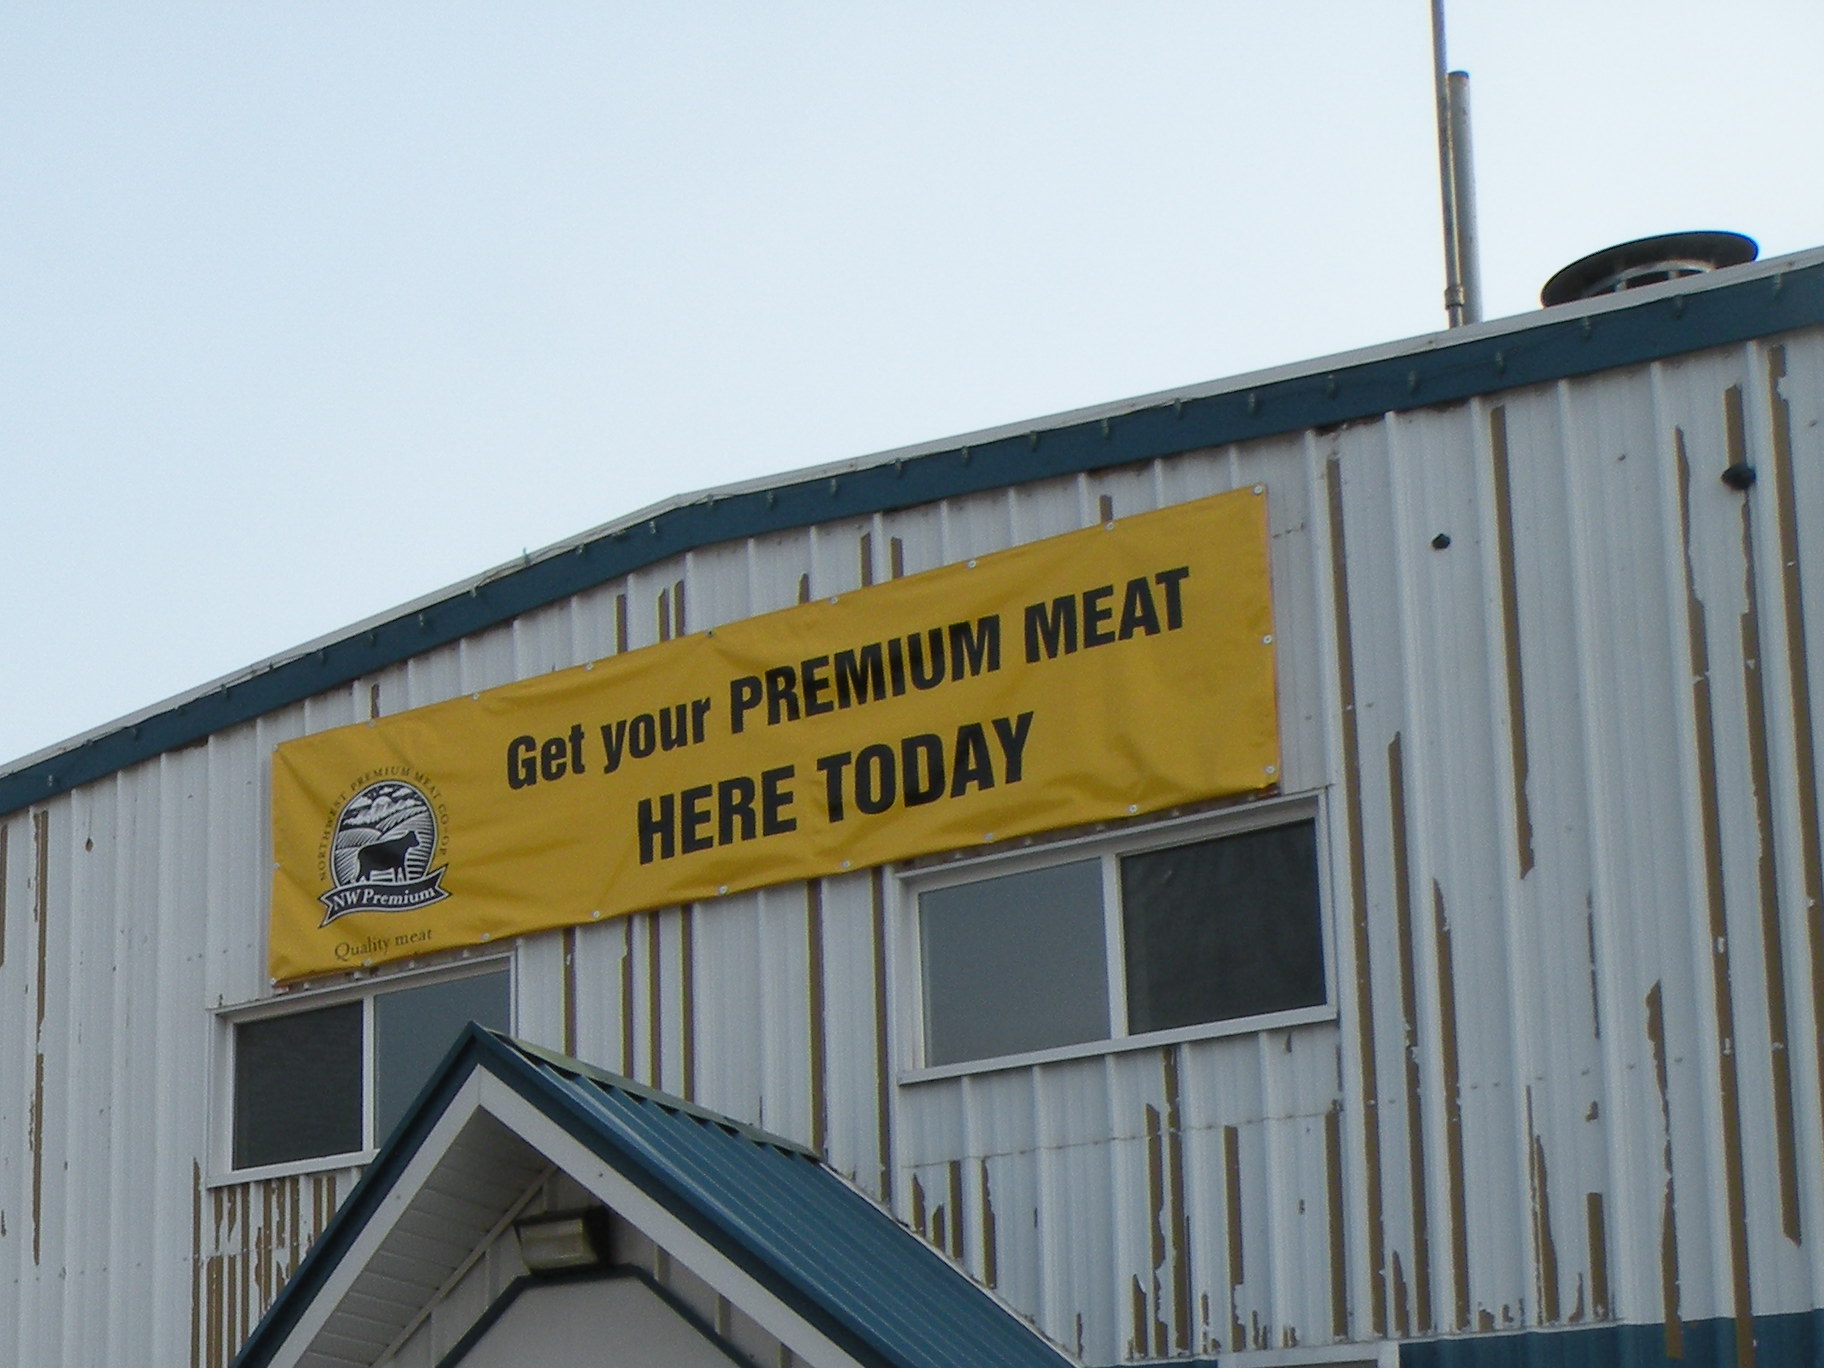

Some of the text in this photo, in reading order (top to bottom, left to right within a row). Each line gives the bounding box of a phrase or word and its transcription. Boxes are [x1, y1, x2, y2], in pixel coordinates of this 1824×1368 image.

[507, 566, 1190, 791] Get your PREMIUM MEAT
[350, 766, 411, 792] PREMIUM
[414, 771, 442, 799] MEAT
[637, 710, 1035, 865] HERE TODAY
[333, 886, 437, 911] NW Premium
[334, 928, 433, 961] Quality meat
